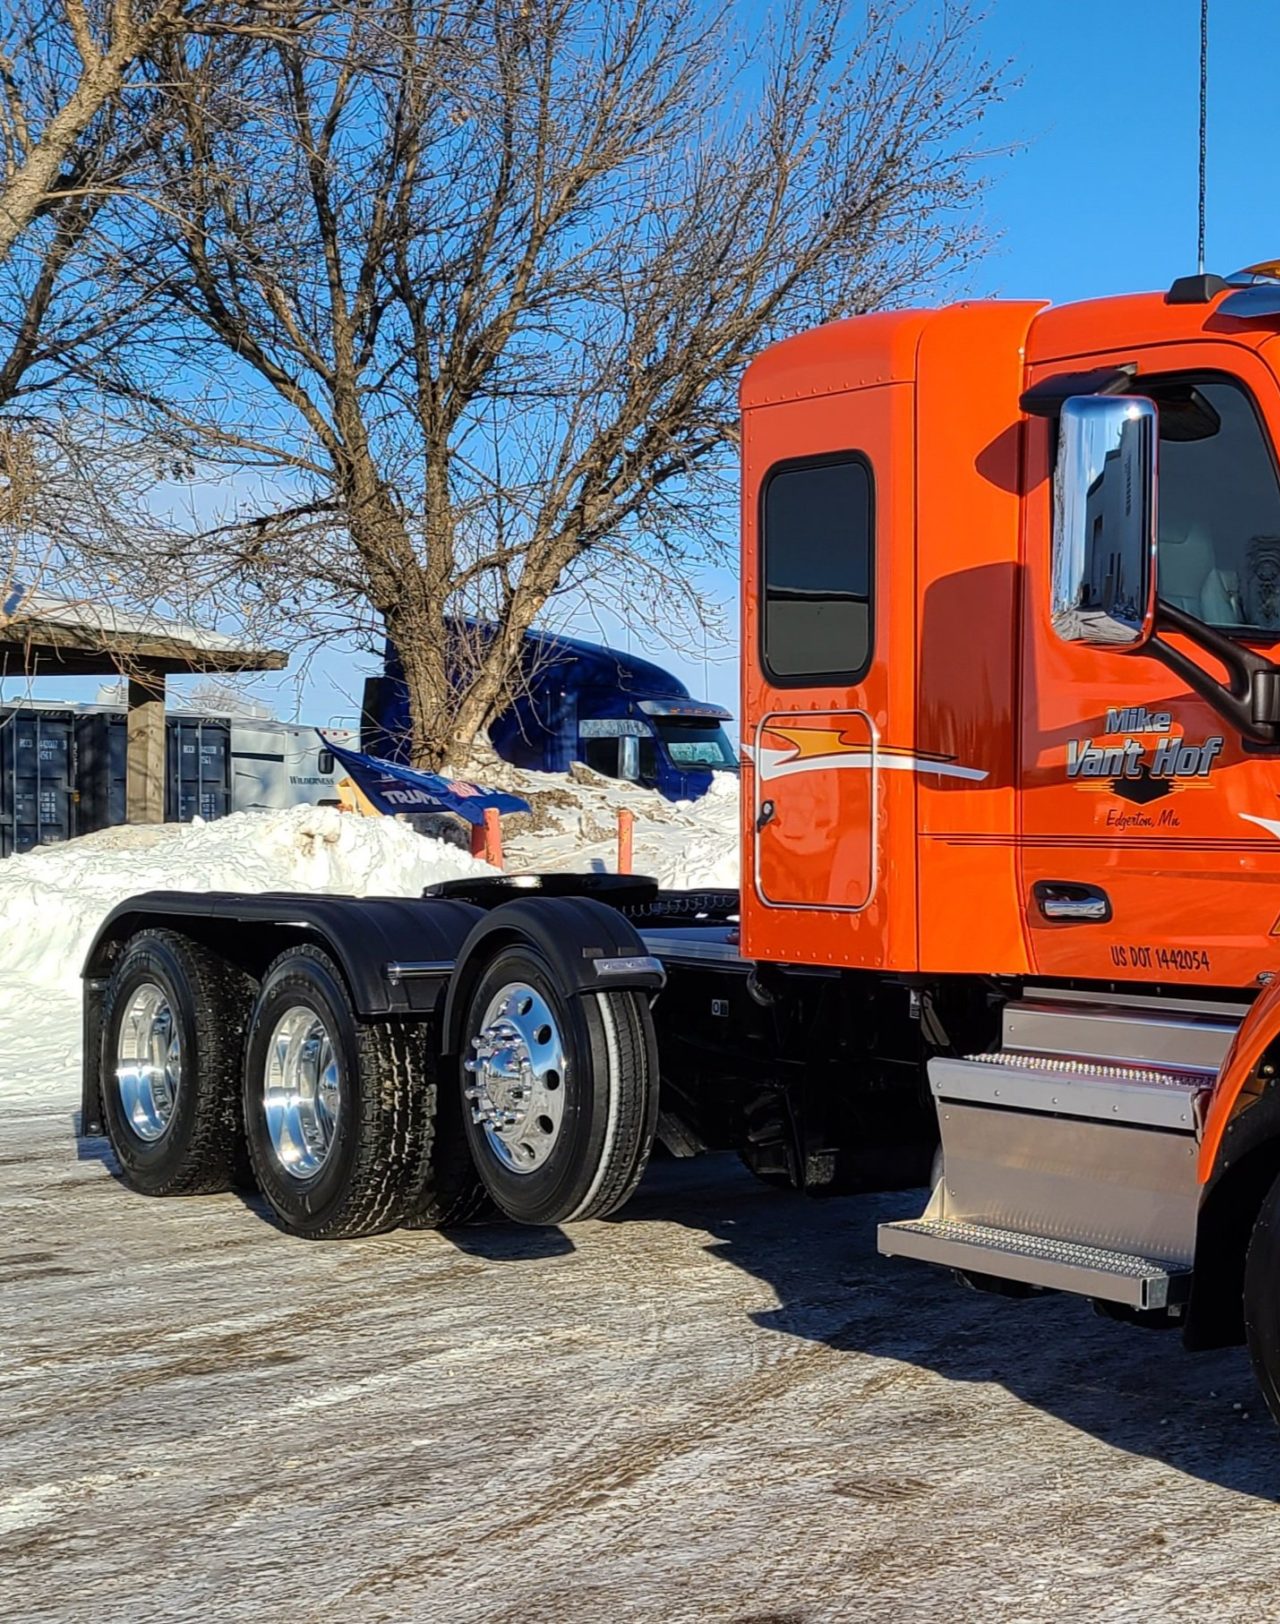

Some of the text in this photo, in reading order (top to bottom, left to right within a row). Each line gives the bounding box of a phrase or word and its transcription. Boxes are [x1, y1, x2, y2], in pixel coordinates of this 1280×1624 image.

[1106, 708, 1171, 734] Mike
[1067, 737, 1224, 779] Van't Hof
[1106, 809, 1181, 832] Edgerton, Mn
[1111, 946, 1210, 972] US DOT 1442054
